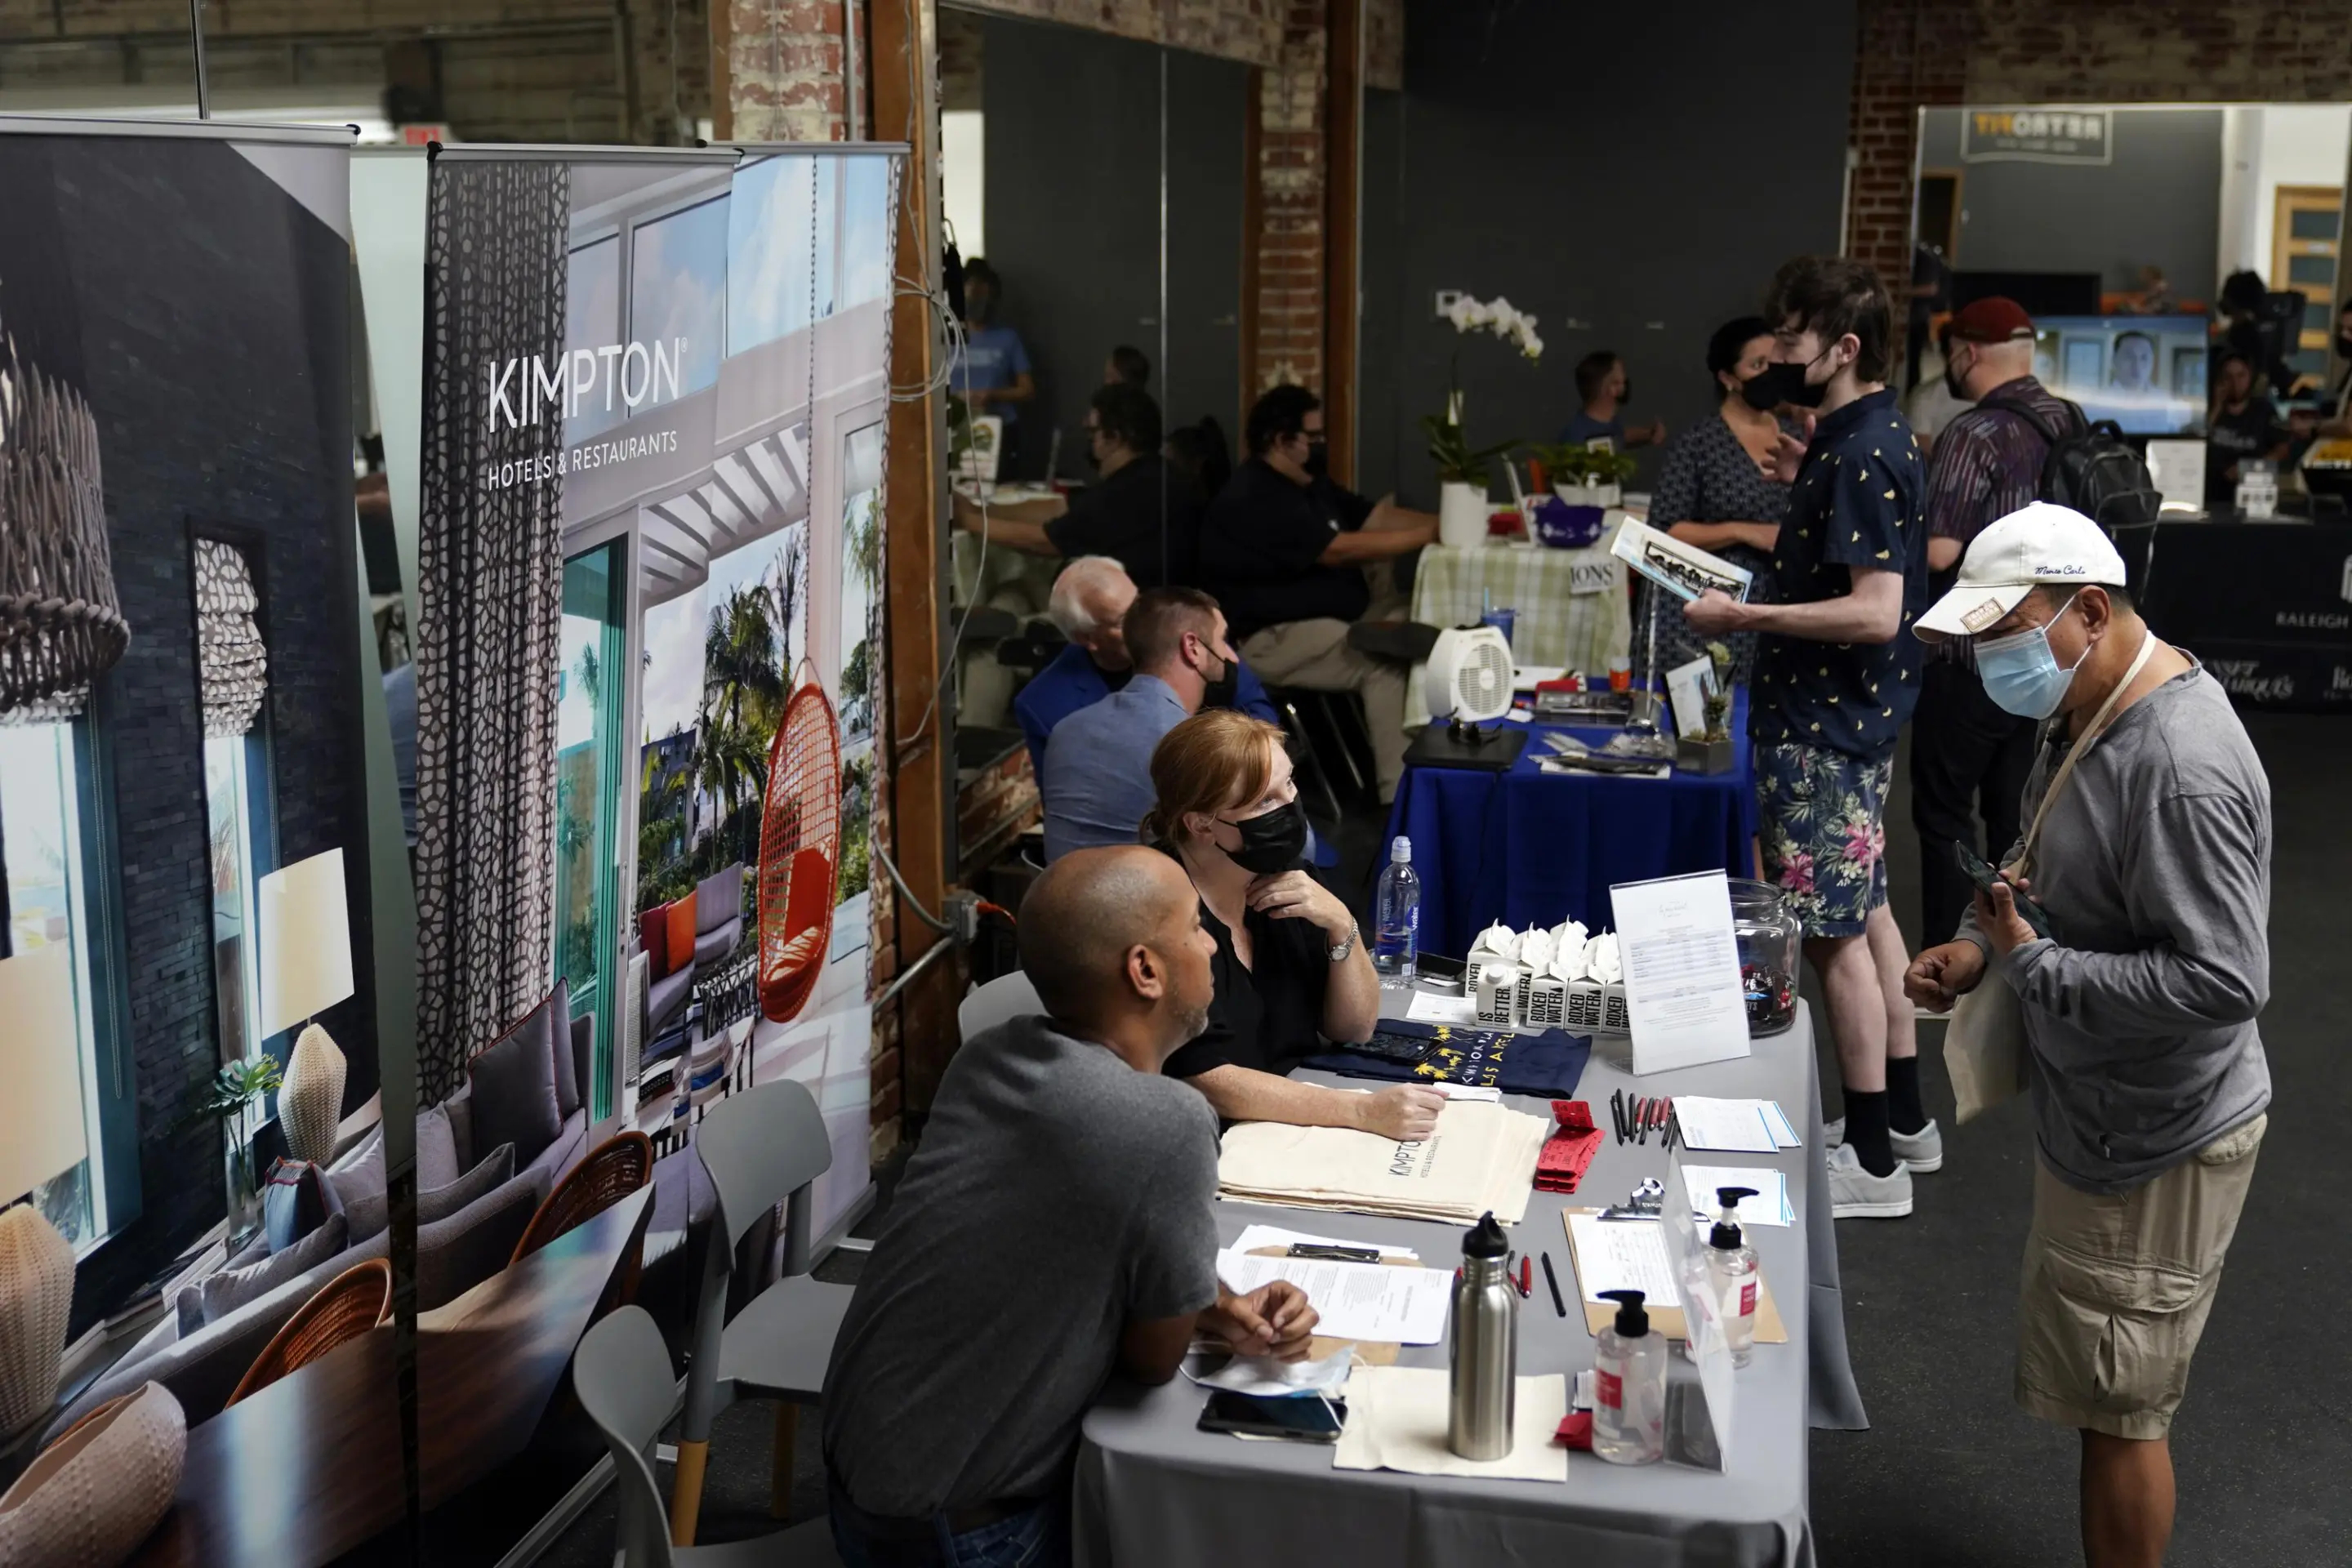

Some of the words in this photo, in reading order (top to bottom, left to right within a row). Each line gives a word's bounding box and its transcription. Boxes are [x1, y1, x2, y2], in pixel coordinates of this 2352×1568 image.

[489, 455, 551, 490] HOTELS
[558, 452, 567, 474] &
[572, 430, 677, 472] RESTAURANTS
[1478, 1012, 1494, 1022] IS
[1494, 987, 1511, 1023] BETTER.
[1530, 991, 1548, 1022] BOXED
[1546, 991, 1564, 1023] WATER
[1568, 993, 1585, 1025] BOXED
[1584, 994, 1601, 1027] WATER
[1606, 996, 1624, 1027] BOXED
[1388, 1140, 1422, 1177] KIMPTO
